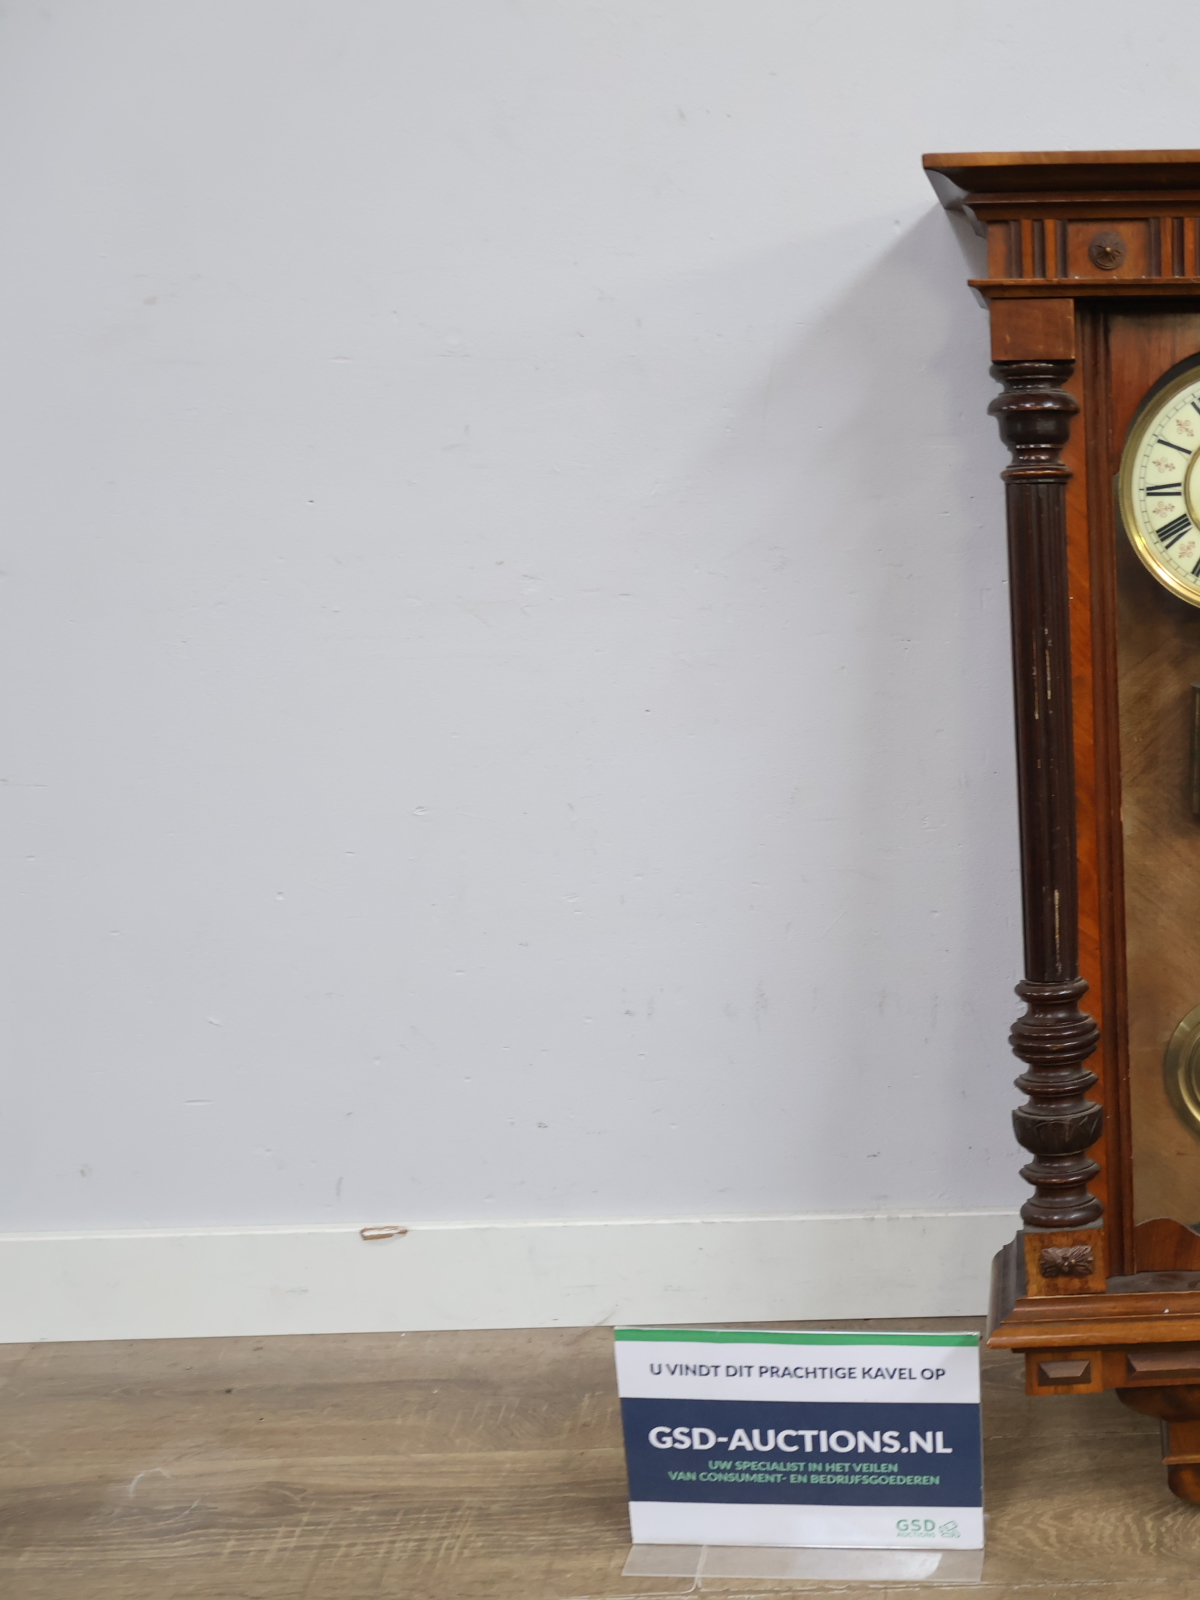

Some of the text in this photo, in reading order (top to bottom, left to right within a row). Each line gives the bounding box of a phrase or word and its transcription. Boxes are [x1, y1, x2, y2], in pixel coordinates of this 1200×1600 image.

[650, 1363, 946, 1381] U VINDT DIT PRACHTIGE KAVEL OP
[648, 1426, 953, 1454] GSD-AUCTIONS.NL
[708, 1460, 898, 1473] UW SPECIALIST IN HET VEILEN
[667, 1471, 940, 1485] VAN CONSUMENT- EN BEDRIJFSGOEDEREN
[896, 1519, 935, 1532] GSD
